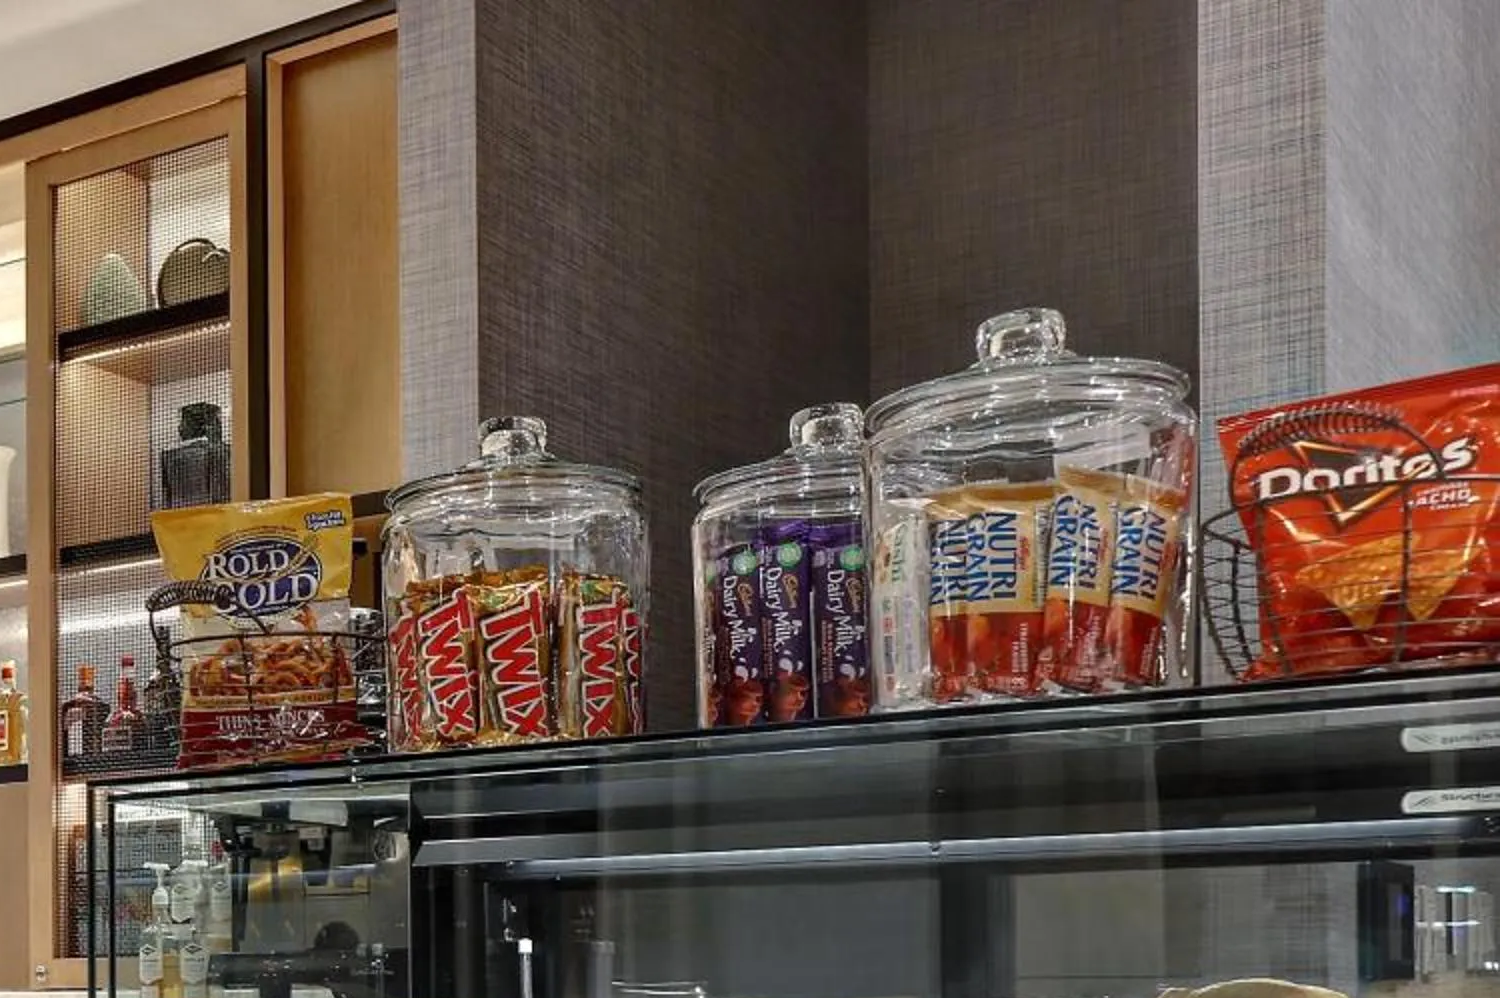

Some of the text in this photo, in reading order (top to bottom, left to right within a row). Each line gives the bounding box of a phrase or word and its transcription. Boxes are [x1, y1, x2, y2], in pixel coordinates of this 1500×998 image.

[1253, 436, 1480, 500] Doritos
[206, 549, 290, 580] ROLD
[966, 513, 990, 602] GRAIN
[986, 512, 1017, 600] NUTRI
[1050, 495, 1082, 587] GRAIN
[1079, 504, 1102, 590] NUTRI
[1112, 506, 1146, 598] GRAIN
[1139, 511, 1168, 603] NUTRI
[722, 575, 747, 660] Dairy Milk
[764, 566, 794, 653] Dairy Milk
[825, 569, 846, 619] Dairy
[832, 613, 854, 657] Milk
[416, 585, 477, 738] TWIX
[480, 587, 550, 738] TWIX
[575, 588, 628, 738] TWIX
